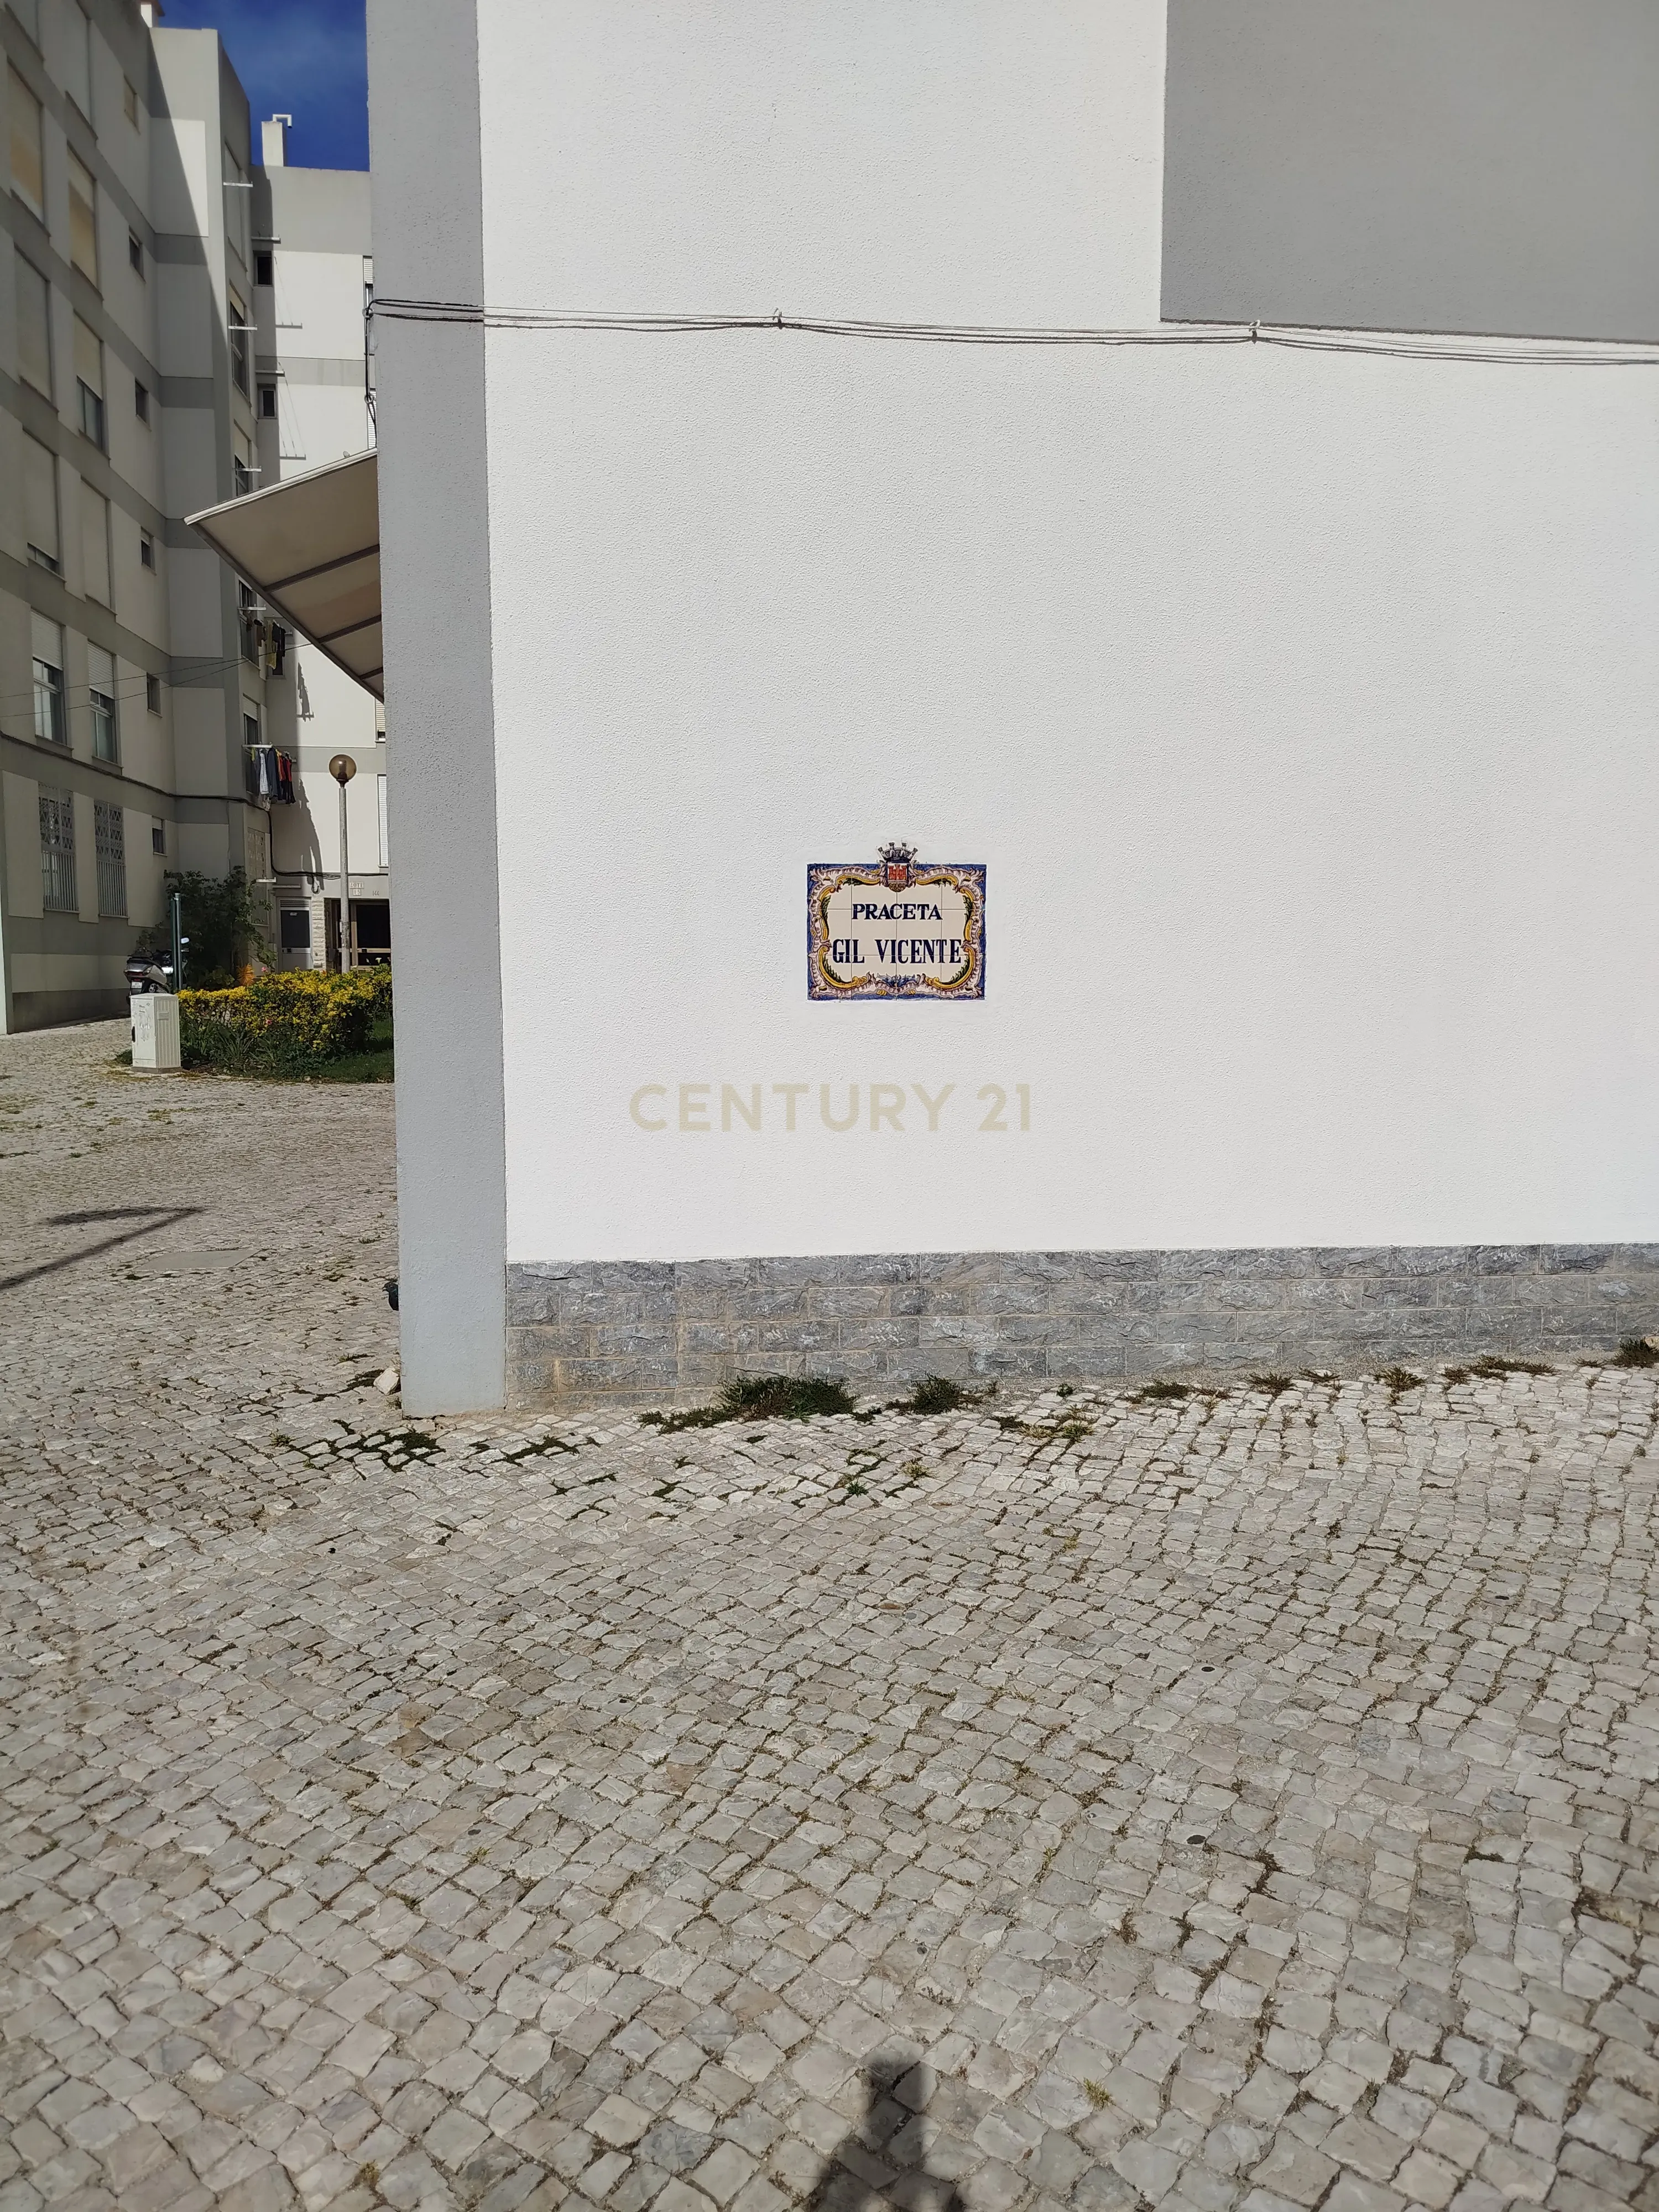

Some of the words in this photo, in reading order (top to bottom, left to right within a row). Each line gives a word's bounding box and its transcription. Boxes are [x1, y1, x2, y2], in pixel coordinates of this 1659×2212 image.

[852, 904, 943, 920] PRACETA
[832, 938, 865, 963] GIL
[874, 939, 962, 963] VICENTE
